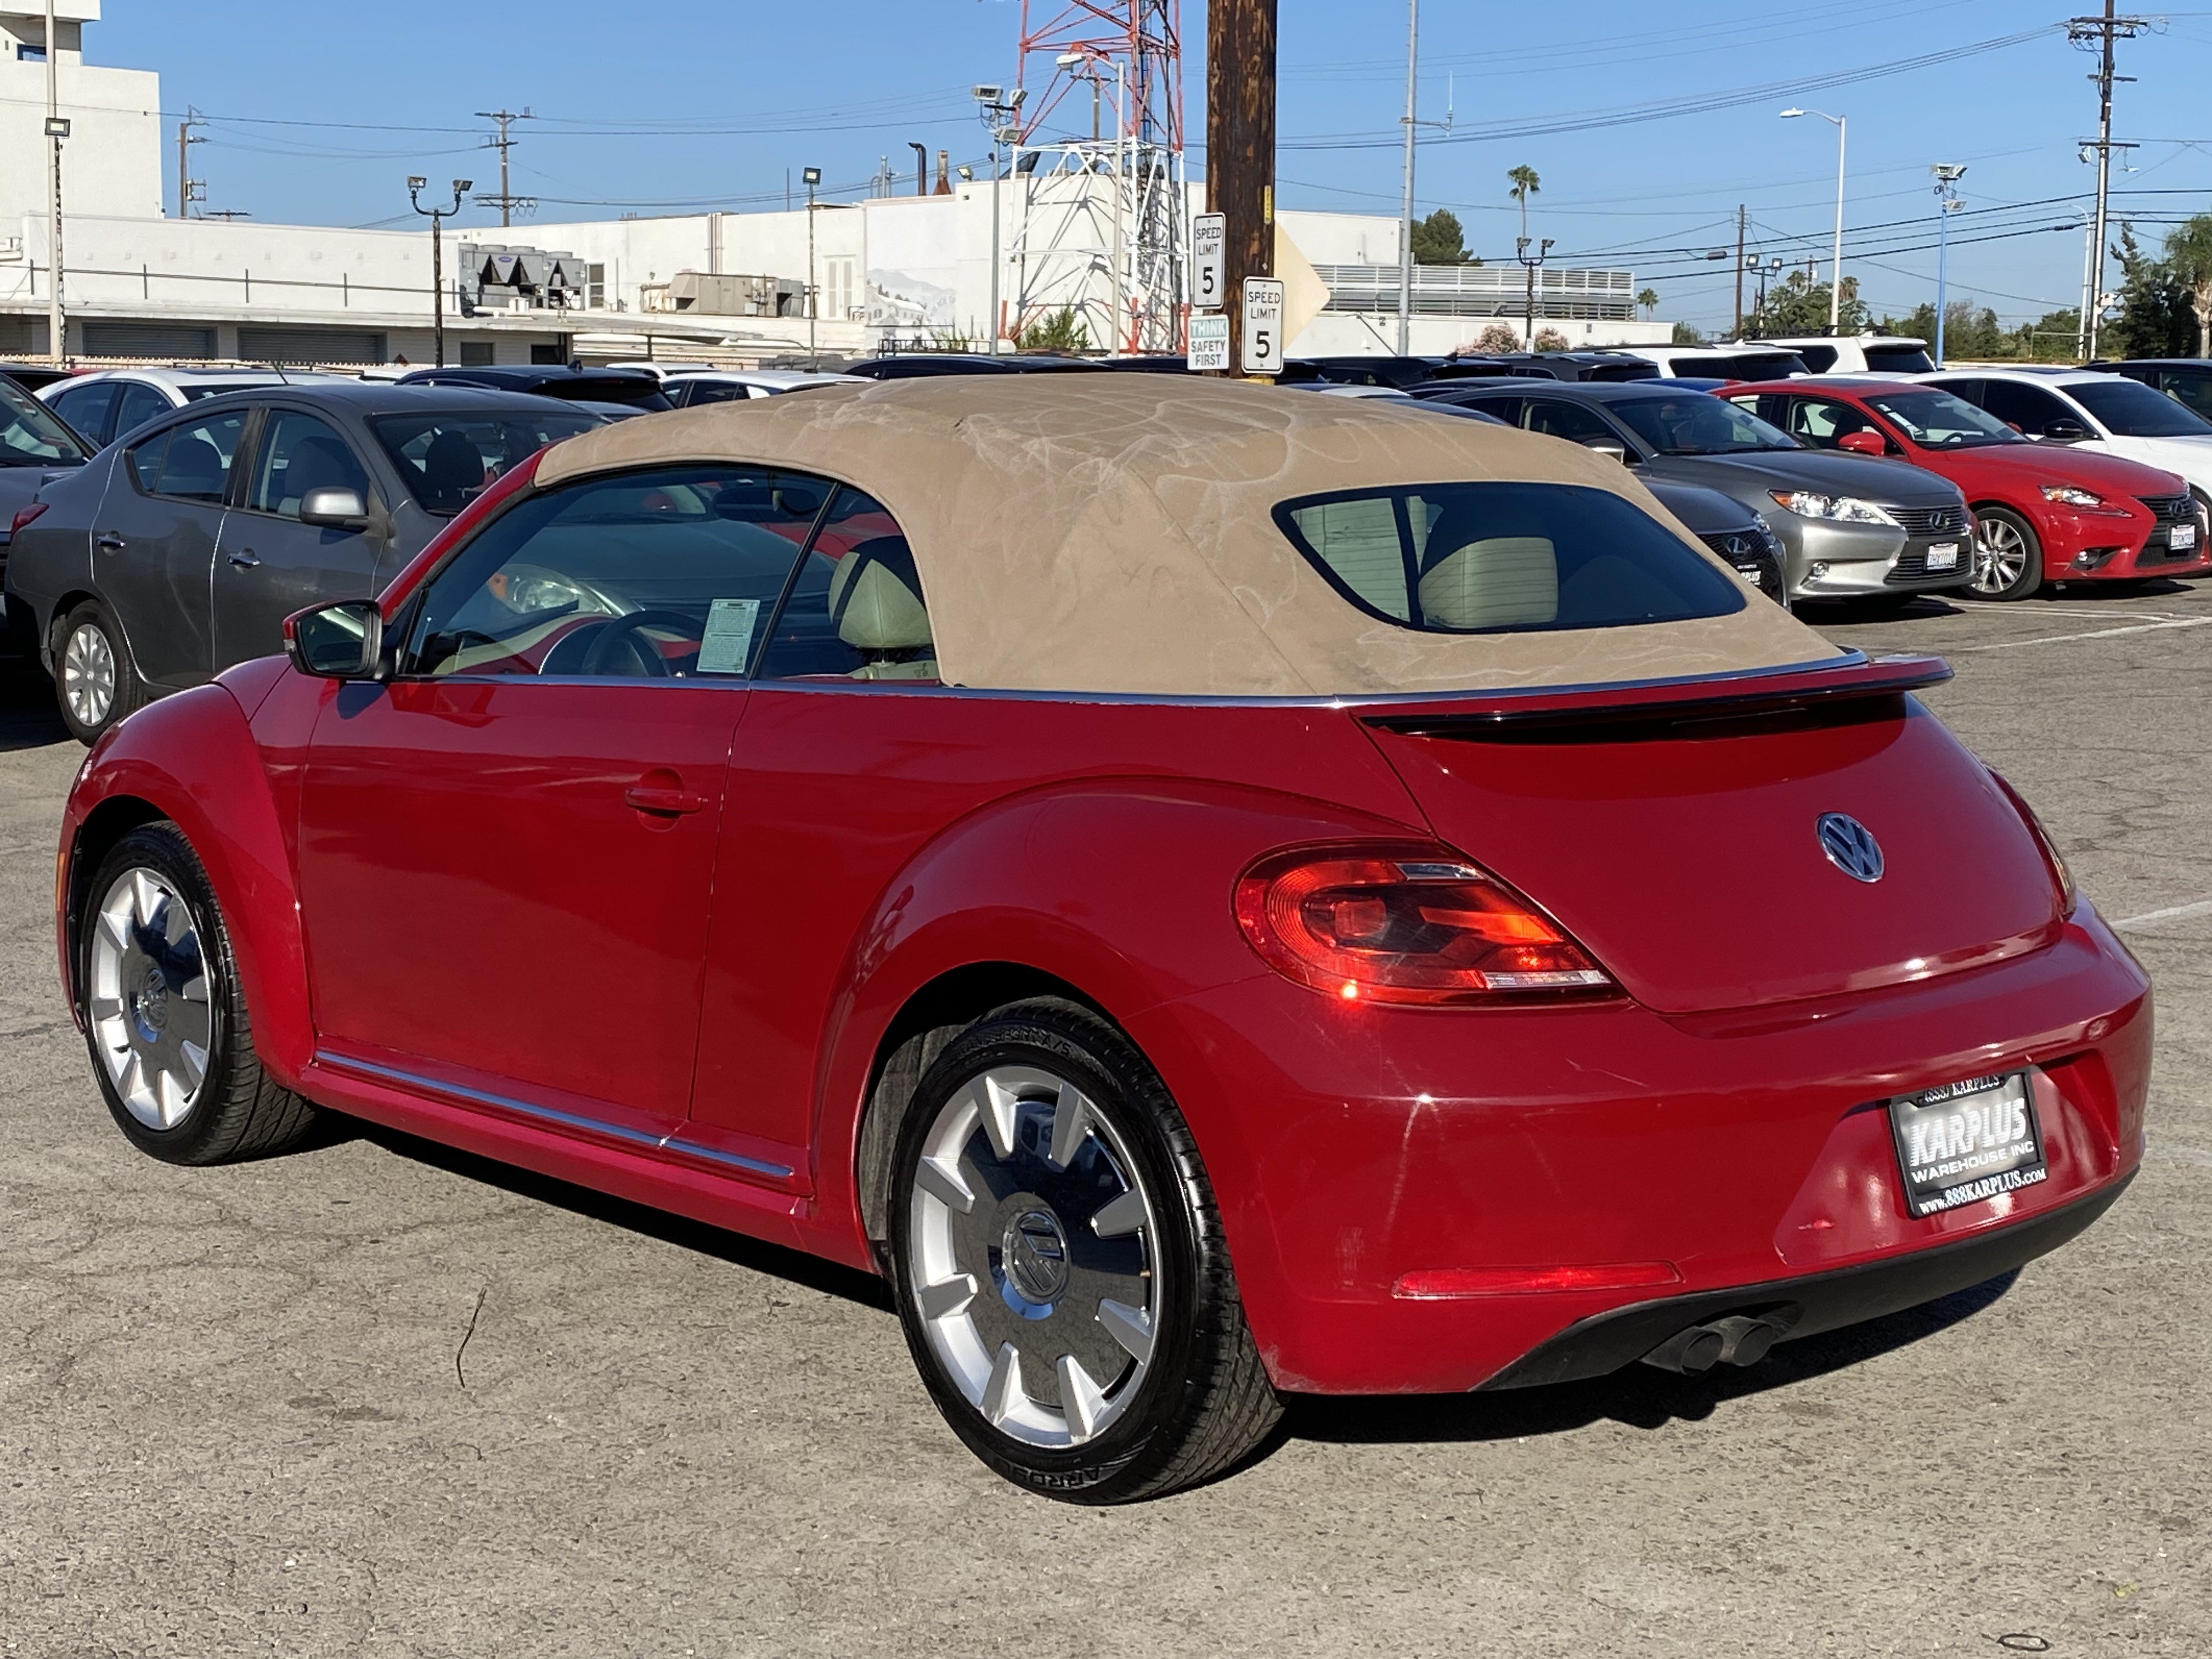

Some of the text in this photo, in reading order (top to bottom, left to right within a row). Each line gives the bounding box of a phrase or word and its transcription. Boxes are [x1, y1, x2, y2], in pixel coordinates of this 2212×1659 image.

[1196, 227, 1222, 240] SPEED
[1198, 244, 1219, 256] LIMIT
[1202, 266, 1214, 295] 5
[1248, 291, 1281, 304] SPEED
[1250, 307, 1277, 320] LIMIT
[1190, 320, 1226, 337] THINK
[1191, 340, 1226, 353] SAFETY
[1255, 330, 1270, 358] 5
[1195, 354, 1222, 366] FIRST
[1952, 1074, 2000, 1096] KARPLUS
[1909, 1097, 2027, 1167] KARPLUS
[1911, 1140, 2034, 1183] WAREHOUSE INC
